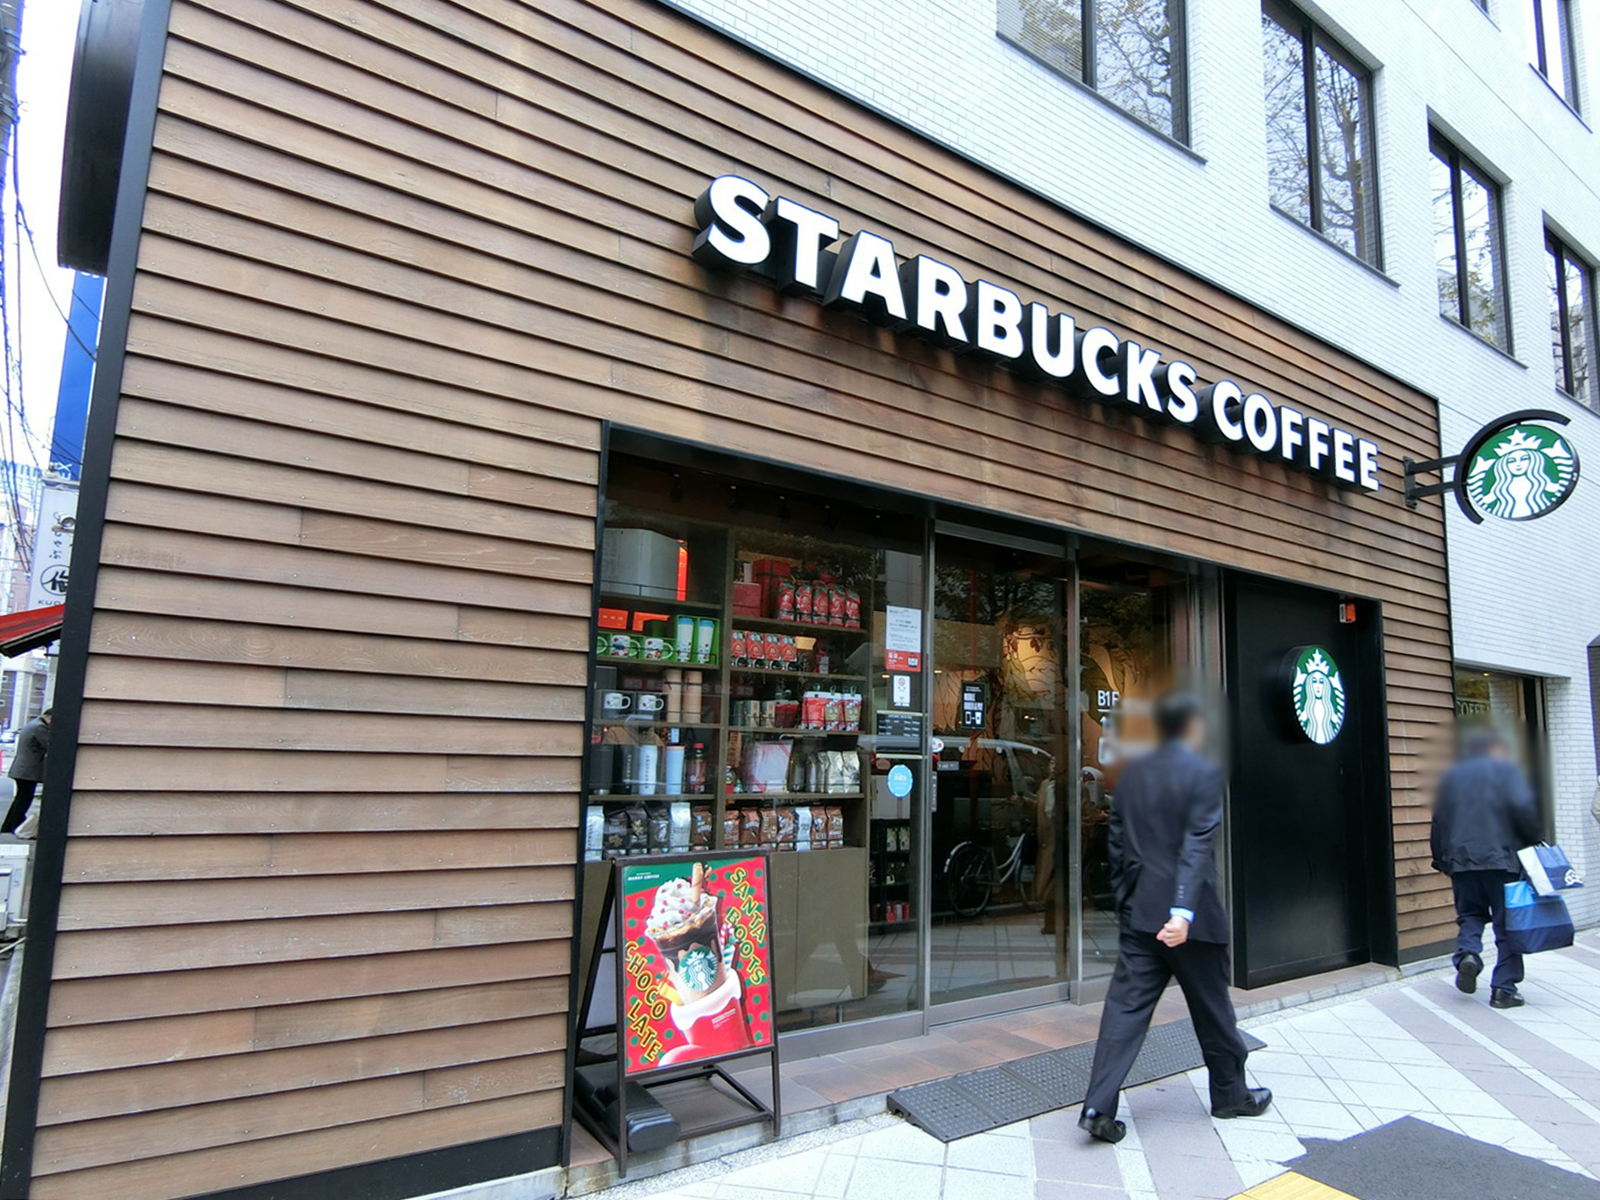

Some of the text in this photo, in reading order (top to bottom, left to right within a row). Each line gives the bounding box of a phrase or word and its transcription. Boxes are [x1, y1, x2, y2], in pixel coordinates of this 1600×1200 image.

[706, 174, 1380, 492] STARBUCKS COFFEE
[730, 866, 767, 944] SANTA
[625, 941, 668, 1020] CHOCO
[725, 906, 766, 986] BOOTS
[627, 999, 663, 1063] LATE
